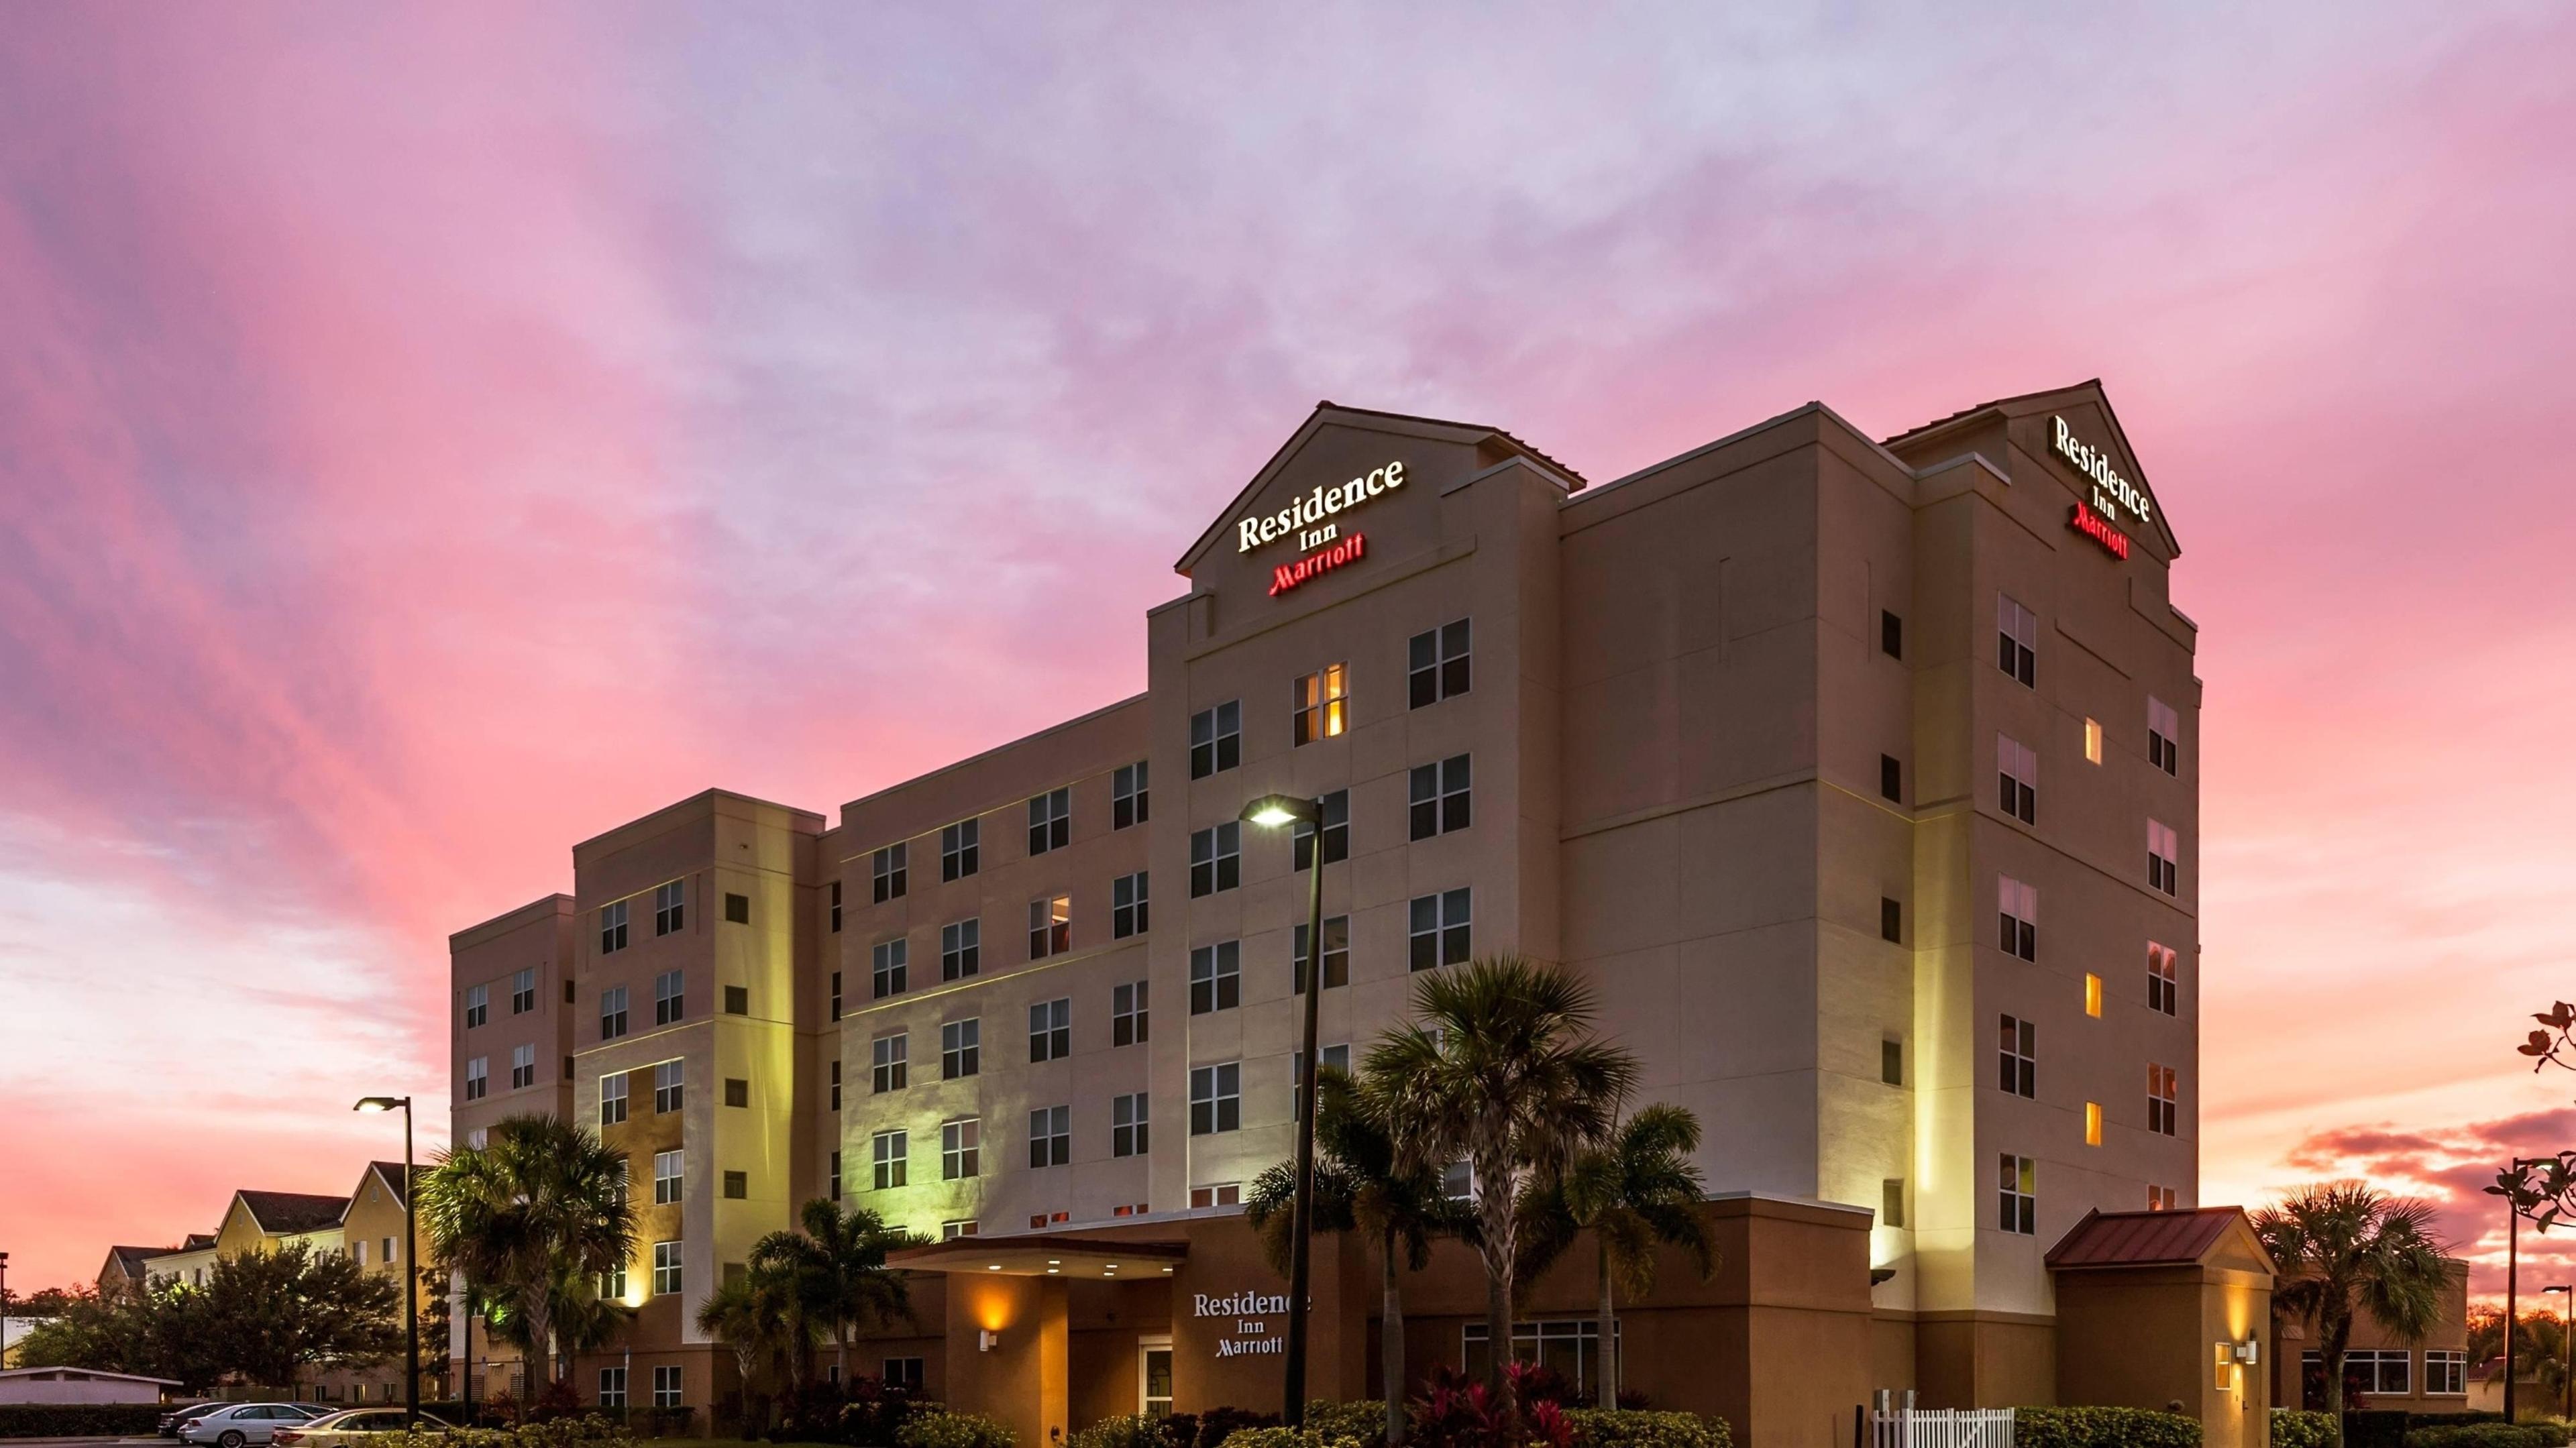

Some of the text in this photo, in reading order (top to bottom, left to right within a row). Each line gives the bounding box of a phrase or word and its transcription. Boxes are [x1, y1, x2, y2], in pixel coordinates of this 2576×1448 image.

[2055, 414, 2150, 522] Residence
[1238, 460, 1404, 553] Residence
[2092, 485, 2116, 521] Inn
[1299, 523, 1338, 551] Inn
[2073, 500, 2129, 560] Marriott
[1269, 532, 1364, 596] Marriott
[1193, 1290, 1311, 1317] Residen
[1237, 1319, 1265, 1334] Inn
[1215, 1336, 1283, 1358] Marriott
